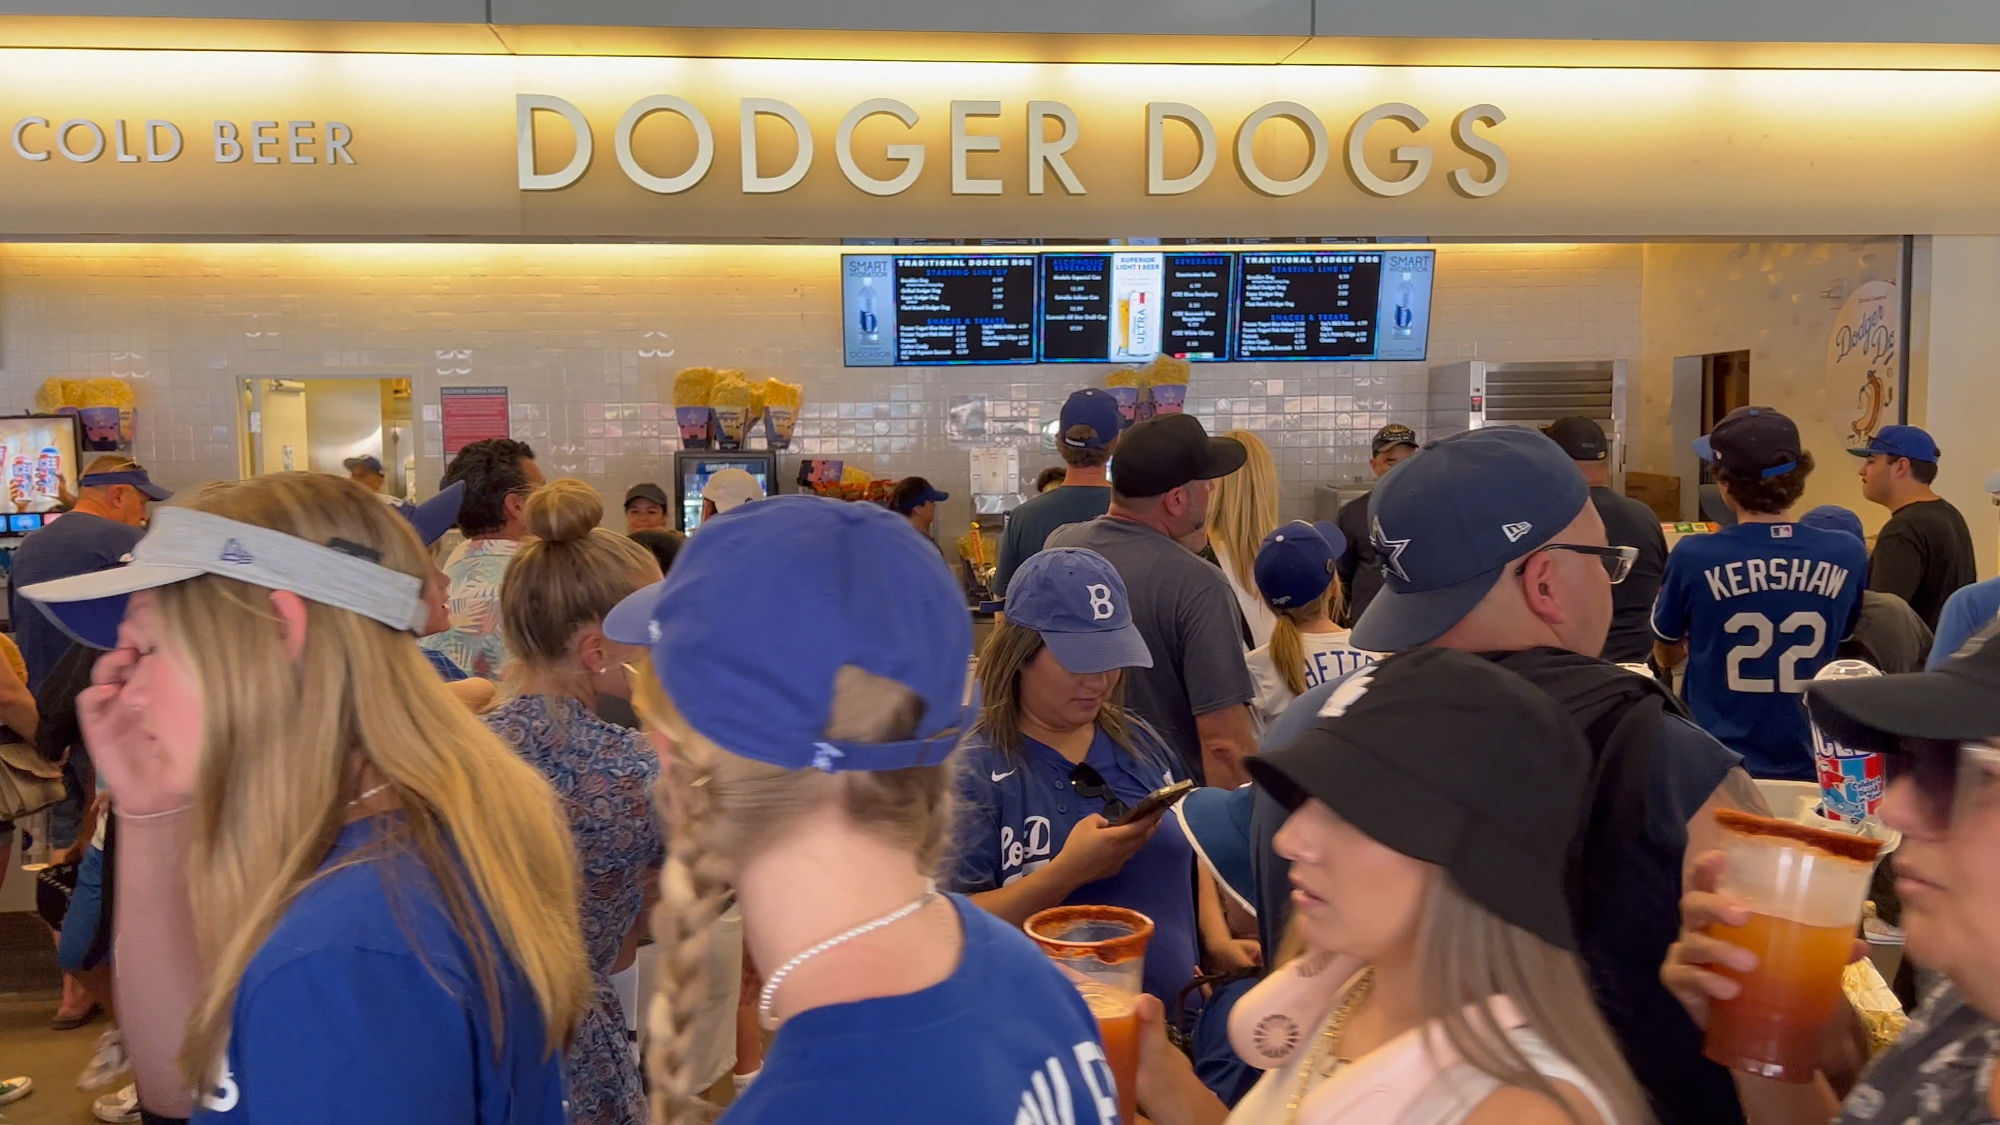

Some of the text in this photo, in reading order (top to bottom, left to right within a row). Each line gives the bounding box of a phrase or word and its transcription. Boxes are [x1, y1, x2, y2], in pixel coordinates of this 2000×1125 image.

[12, 116, 357, 166] COLD BEER
[515, 93, 1510, 199] DODGER DOGS
[849, 260, 888, 272] SMART
[1244, 256, 1312, 264] TRADITIONAL
[1390, 255, 1430, 267] SMART
[1136, 308, 1146, 345] ULTRA
[1836, 304, 1885, 364] Dodger
[1704, 558, 1850, 601] KERSHAW
[1086, 583, 1115, 622] B
[1723, 611, 1827, 693] 22
